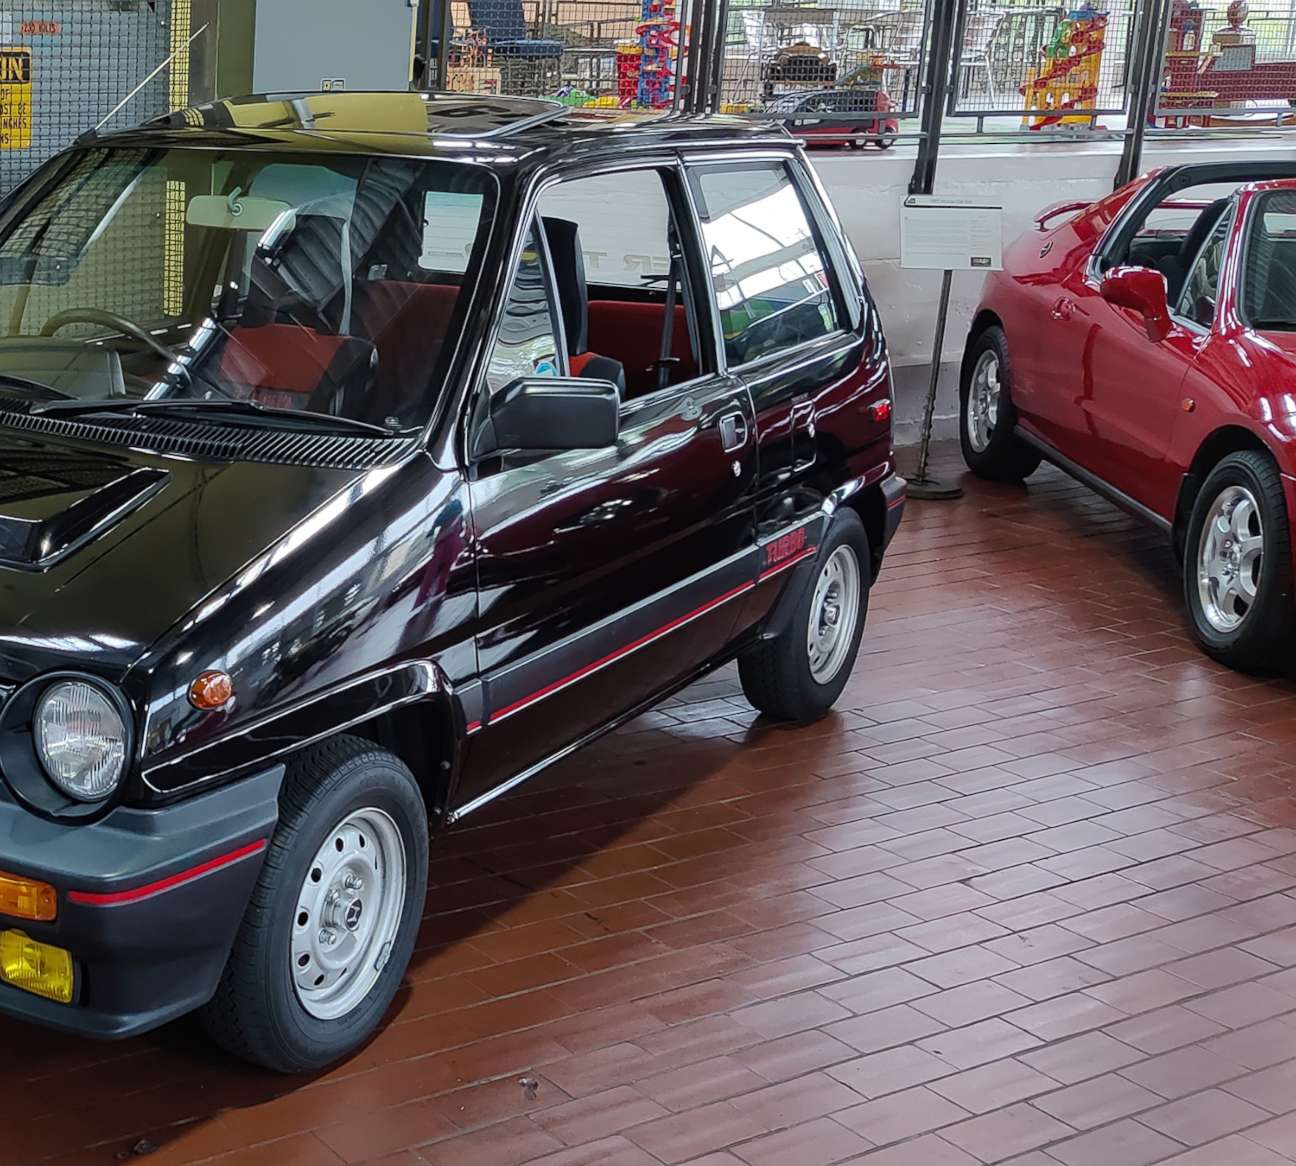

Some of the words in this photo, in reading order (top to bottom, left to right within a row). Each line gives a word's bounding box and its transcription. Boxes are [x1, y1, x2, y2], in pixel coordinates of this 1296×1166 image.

[0, 89, 10, 100] OF
[18, 103, 27, 115] BE
[1, 117, 27, 129] INCHES
[766, 528, 807, 565] TURBO
